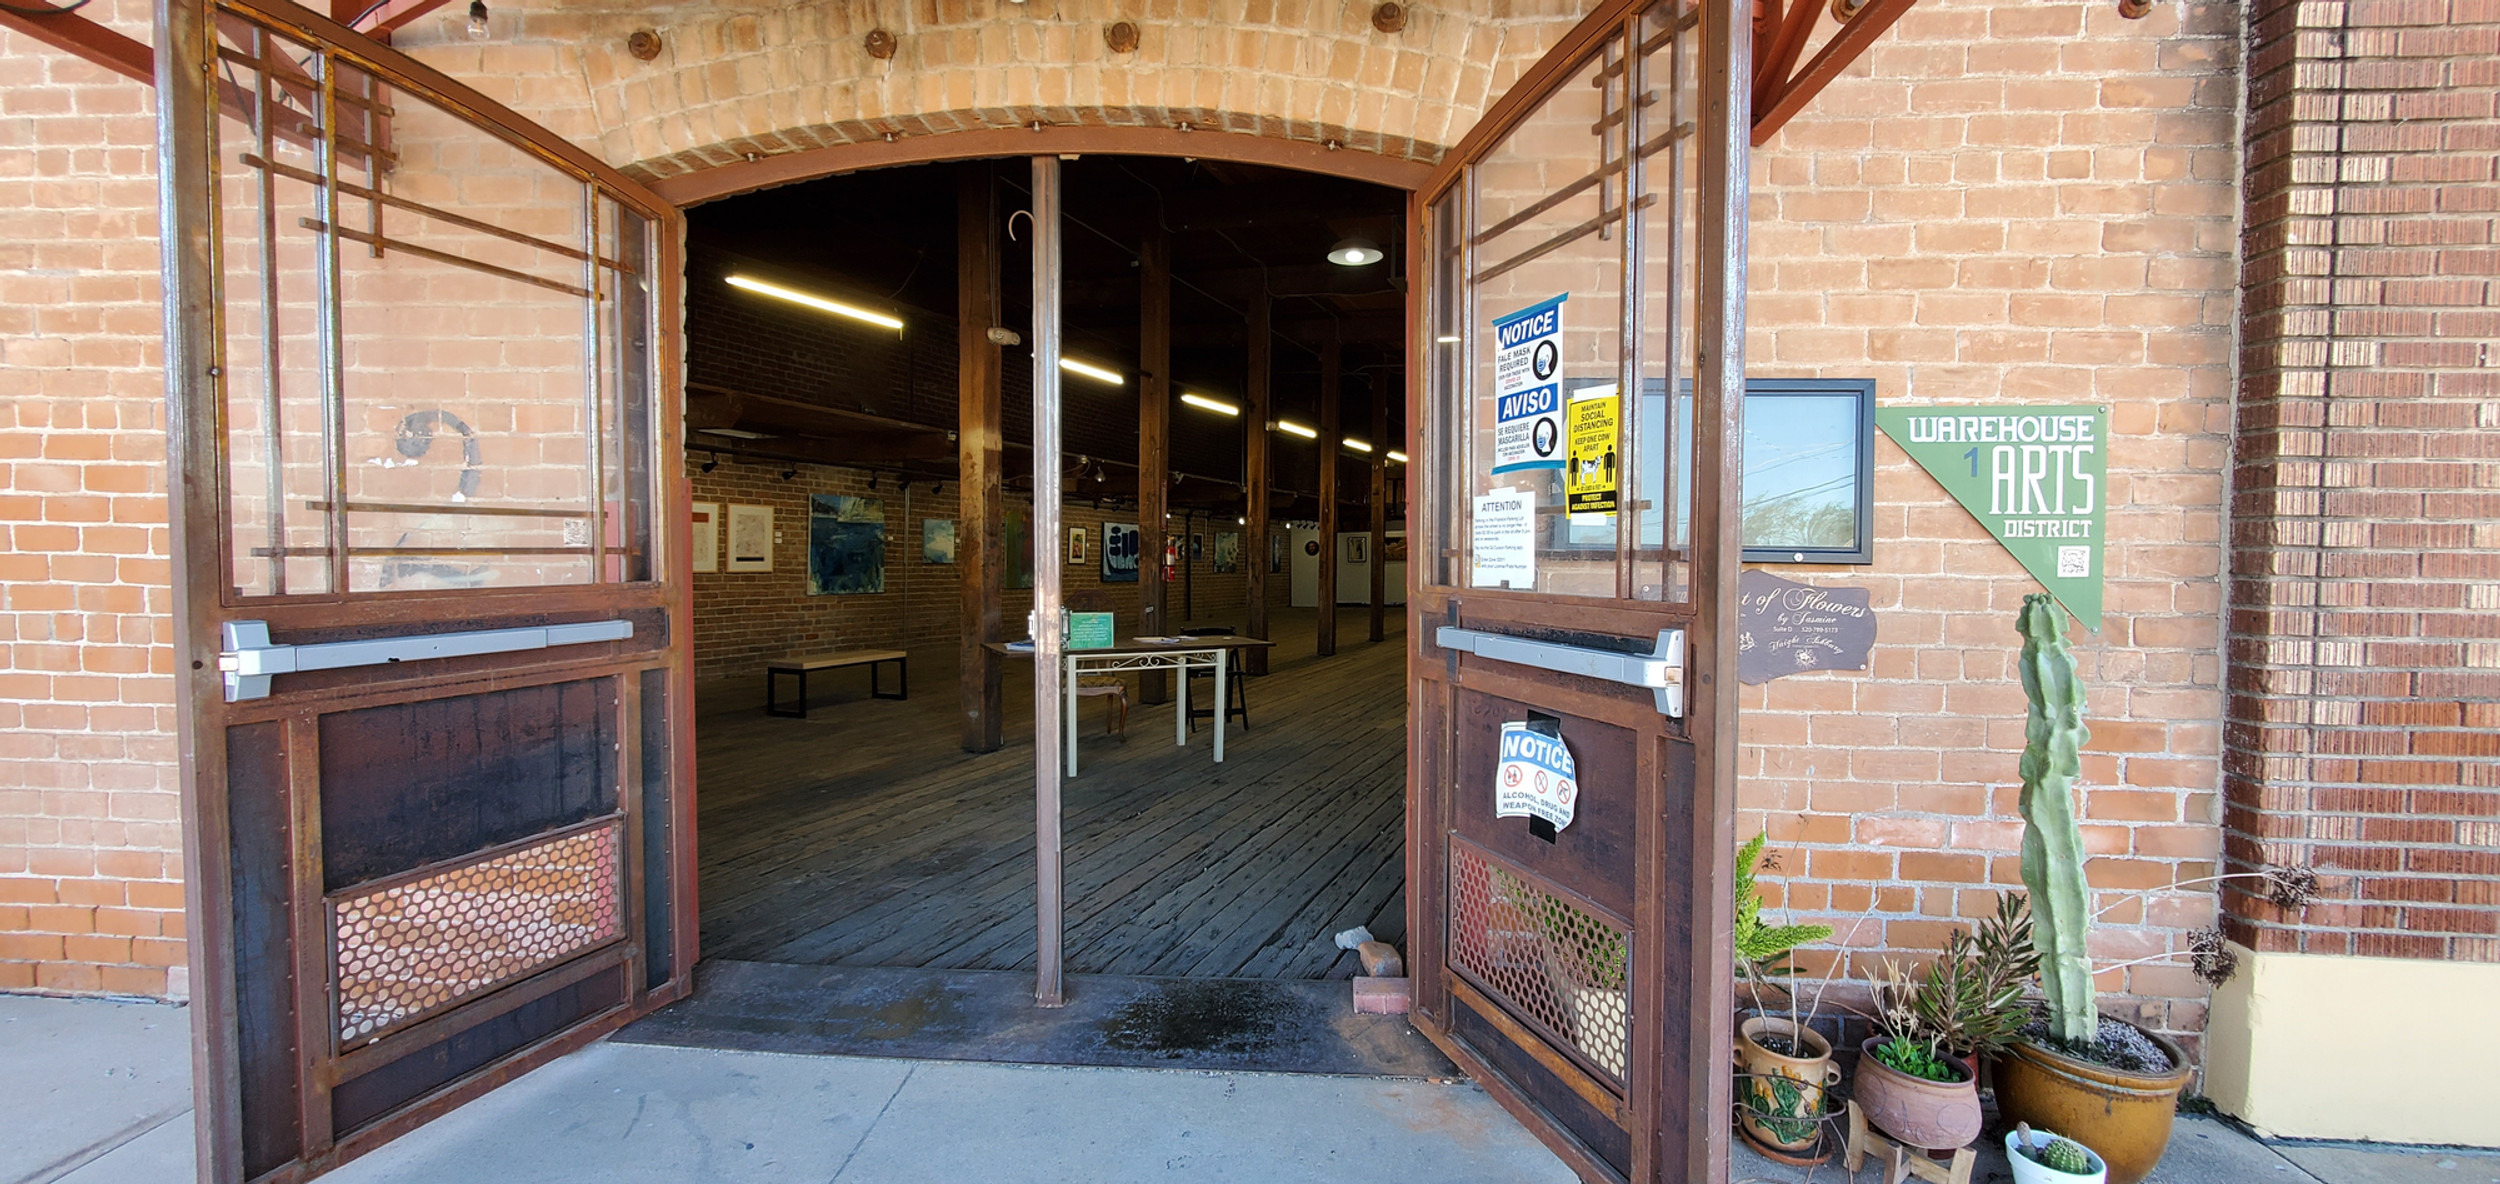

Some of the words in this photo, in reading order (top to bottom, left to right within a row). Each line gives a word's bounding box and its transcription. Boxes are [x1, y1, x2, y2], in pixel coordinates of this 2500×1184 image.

[1502, 310, 1554, 346] NOTICE
[1512, 346, 1531, 358] MASK
[1498, 356, 1529, 372] REQUIRED
[1502, 388, 1552, 420] AVISO
[1581, 402, 1606, 412] MAINTAIN
[1573, 418, 1614, 433] DISTANCING
[1581, 410, 1605, 422] SOCIAL
[1504, 422, 1530, 434] REQUIERE
[1906, 415, 2095, 443] WAREHOUSE
[1498, 432, 1530, 445] MASCARILLA
[1964, 446, 1978, 478] 1
[1988, 444, 2094, 515] ARTS
[1482, 500, 1522, 512] ATTENTION
[2003, 519, 2092, 538] DISTRICT
[1755, 588, 1781, 615] of
[1783, 588, 1866, 618] Flowers
[1778, 612, 1789, 625] by
[1792, 611, 1837, 626] Jasmine
[1504, 736, 1572, 774] NOTICE
[1502, 801, 1536, 812] WEAPON
[1538, 807, 1553, 820] FREE
[1503, 792, 1539, 805] ALCOHOL,
[1540, 798, 1558, 811] DRUG
[1559, 807, 1570, 818] AND
